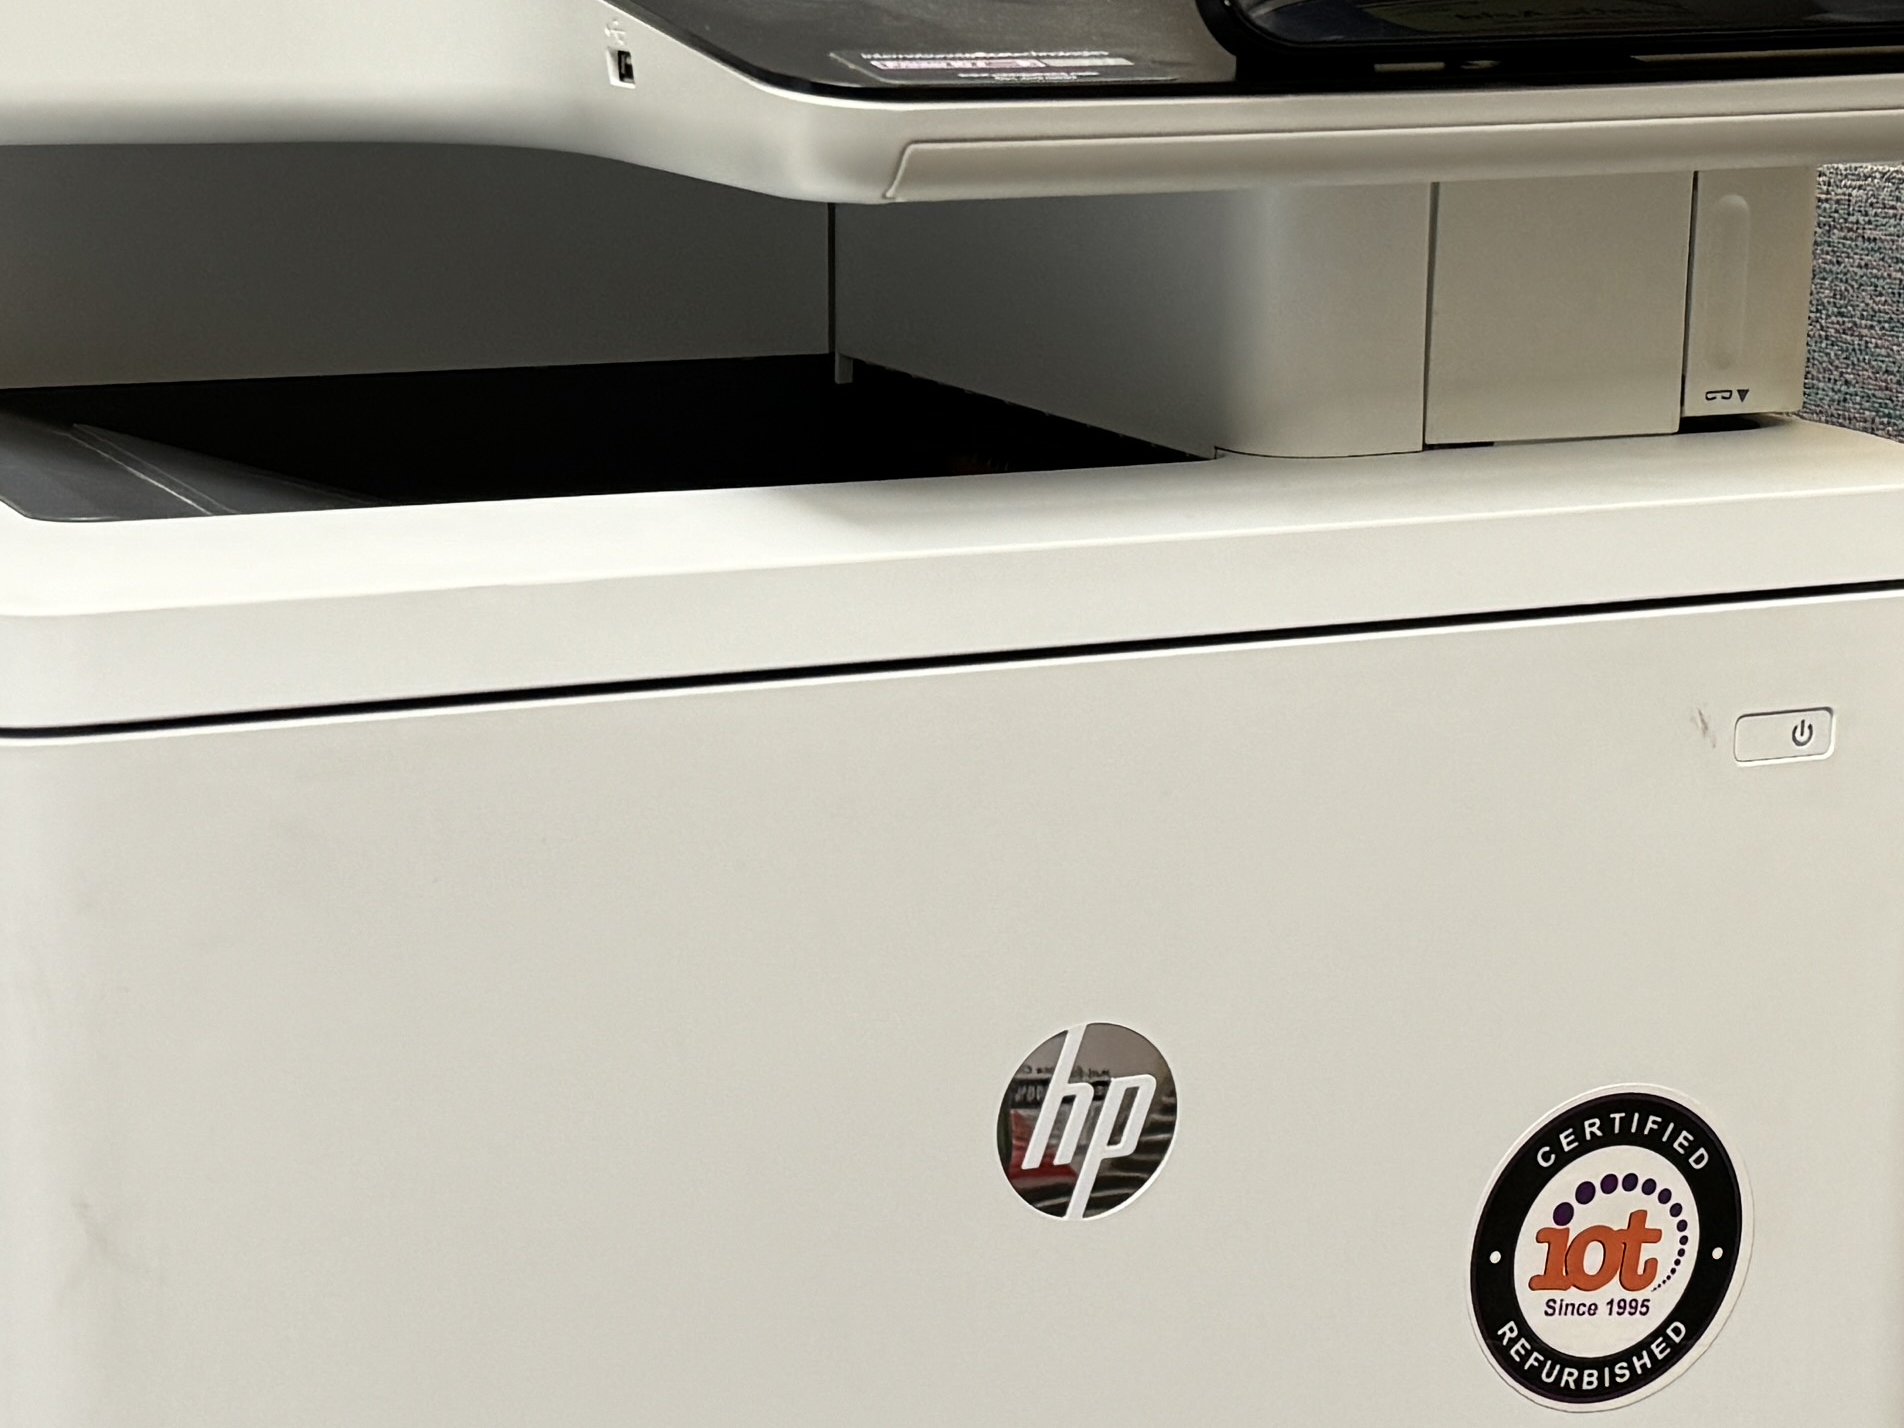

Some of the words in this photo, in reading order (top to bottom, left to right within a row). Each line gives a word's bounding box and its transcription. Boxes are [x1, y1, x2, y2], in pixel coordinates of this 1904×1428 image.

[1021, 1022, 1157, 1221] hp
[1536, 1111, 1710, 1172] CERTIFIED
[1528, 1201, 1663, 1293] iot
[1543, 1298, 1598, 1318] Since
[1605, 1297, 1651, 1318] 1995
[1496, 1319, 1688, 1392] REFURBISHED
